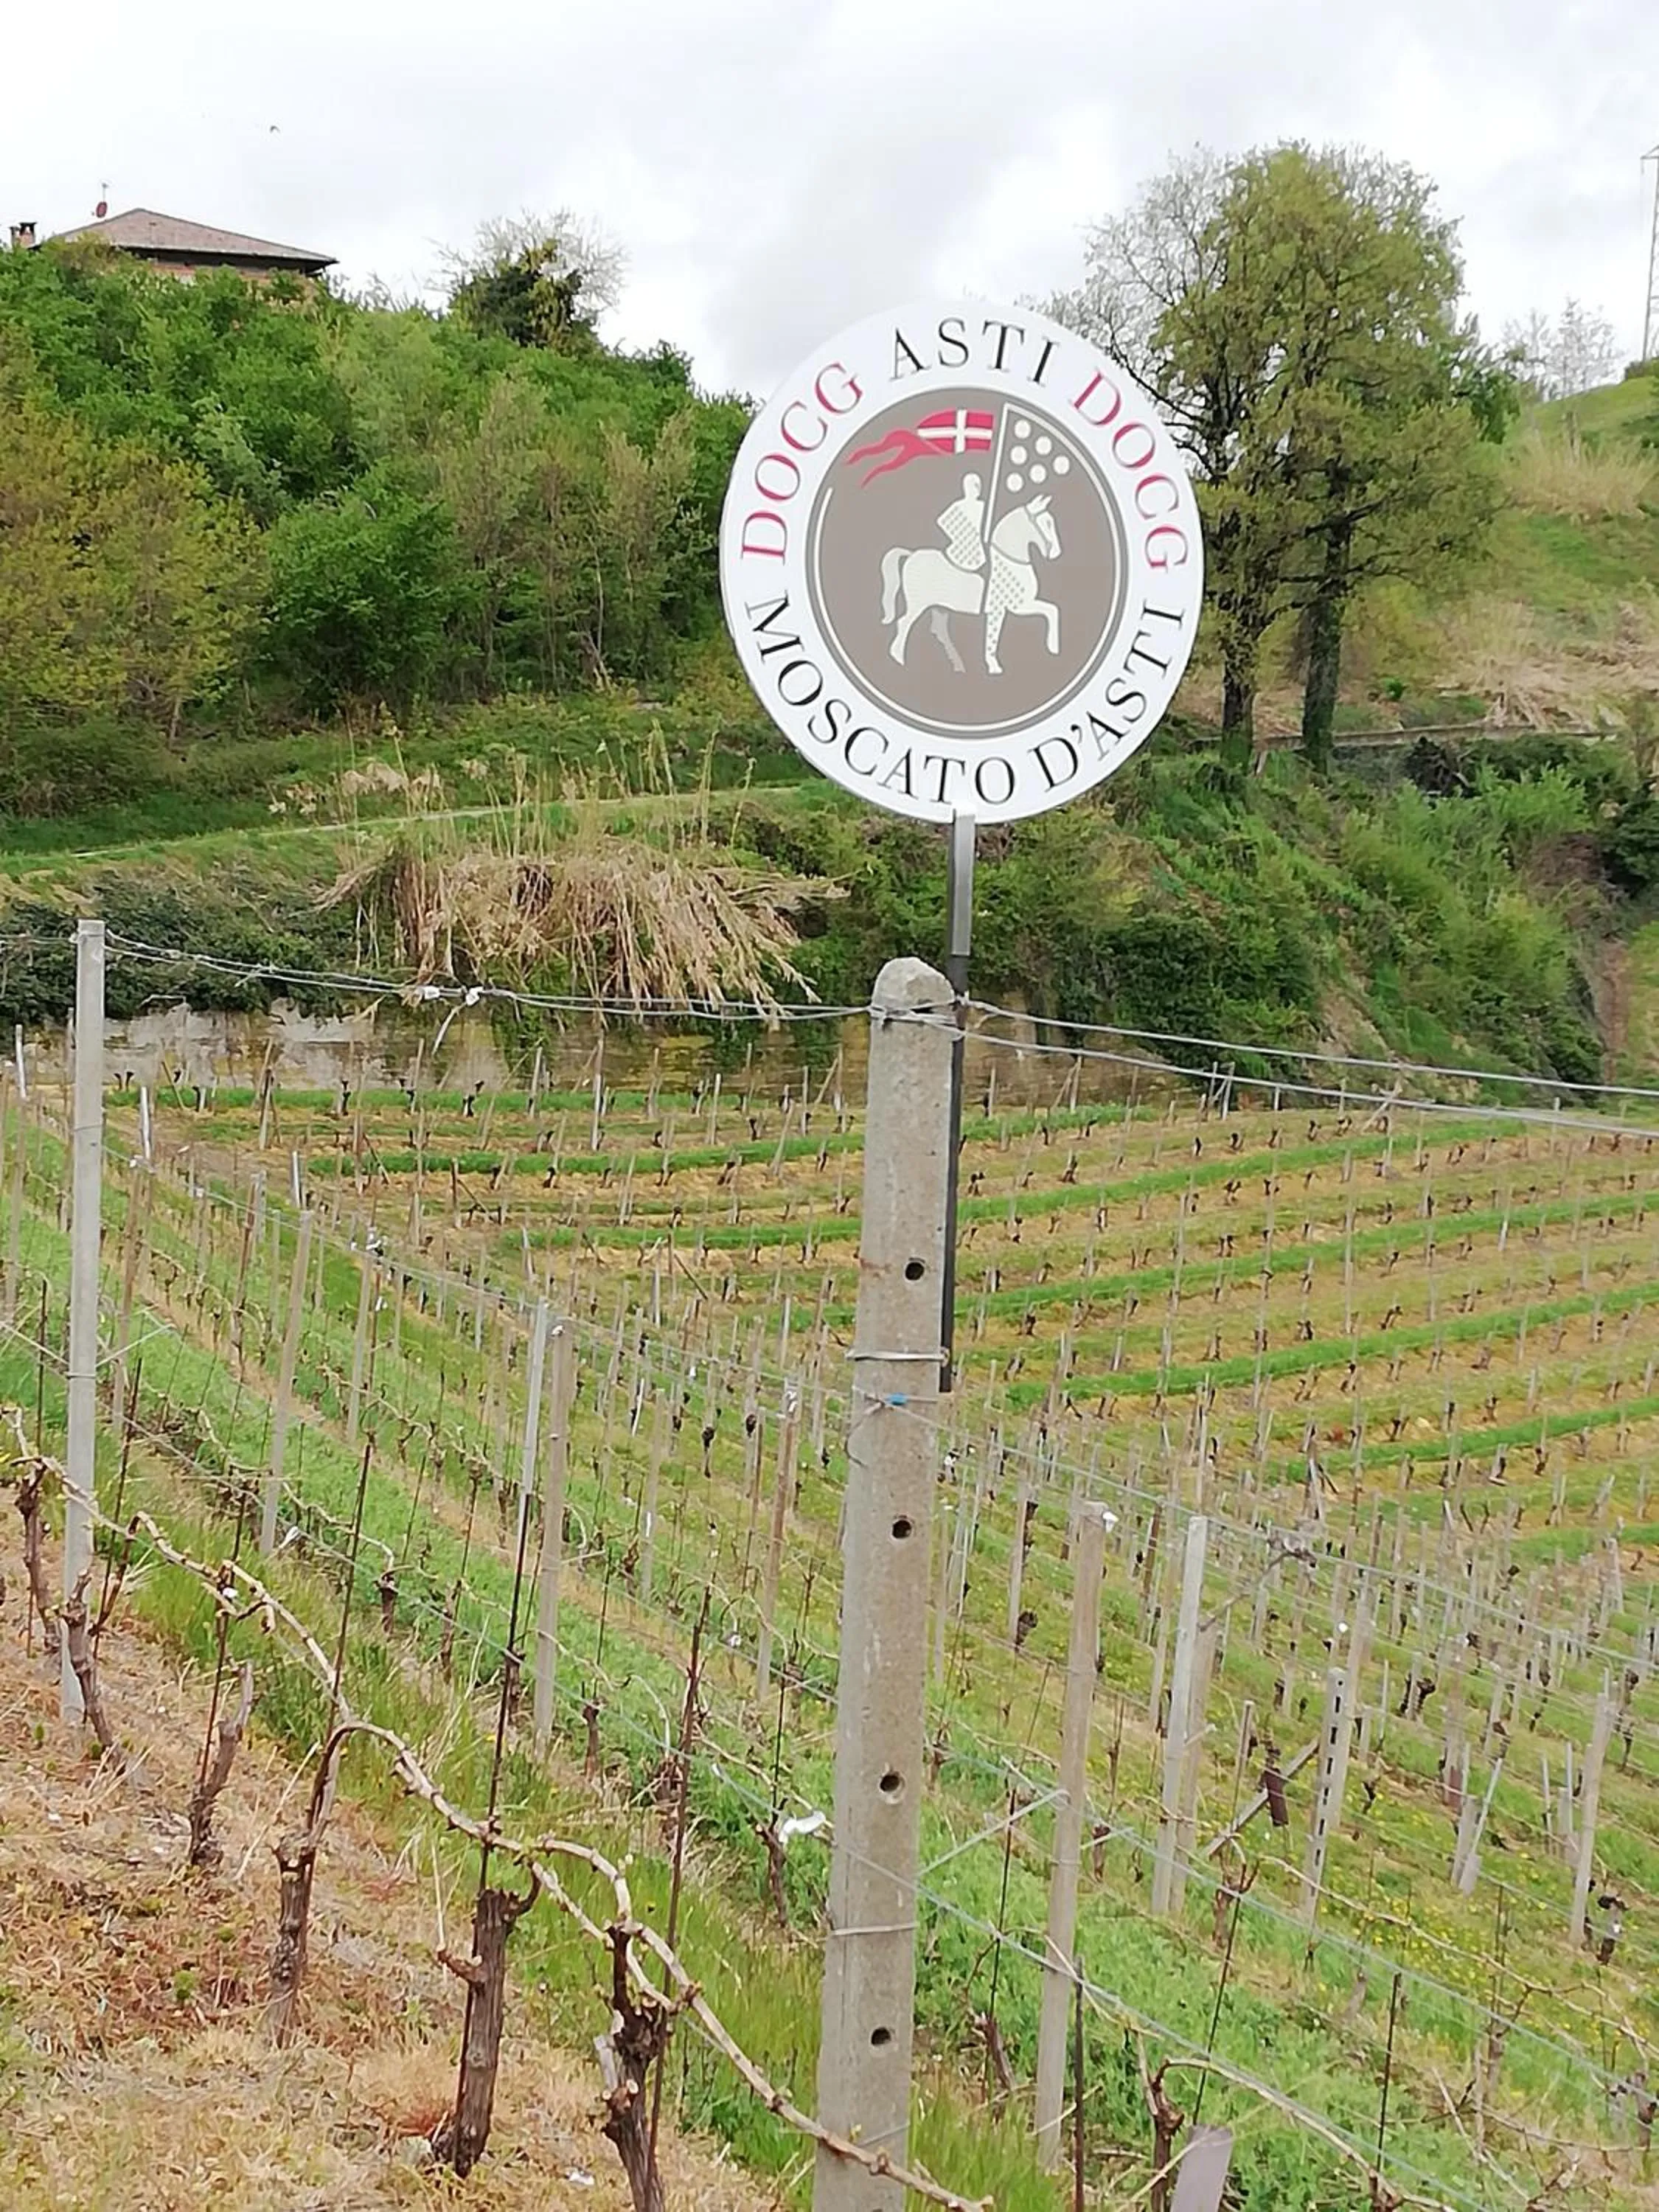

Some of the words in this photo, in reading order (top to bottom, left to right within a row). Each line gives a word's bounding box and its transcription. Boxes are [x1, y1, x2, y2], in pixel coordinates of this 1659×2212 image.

[741, 362, 864, 566] DOCG
[889, 318, 1060, 387] ASTI
[1072, 370, 1189, 574] DOCG
[744, 591, 1015, 805] MOSCATO
[1027, 599, 1184, 792] D'ASTI
